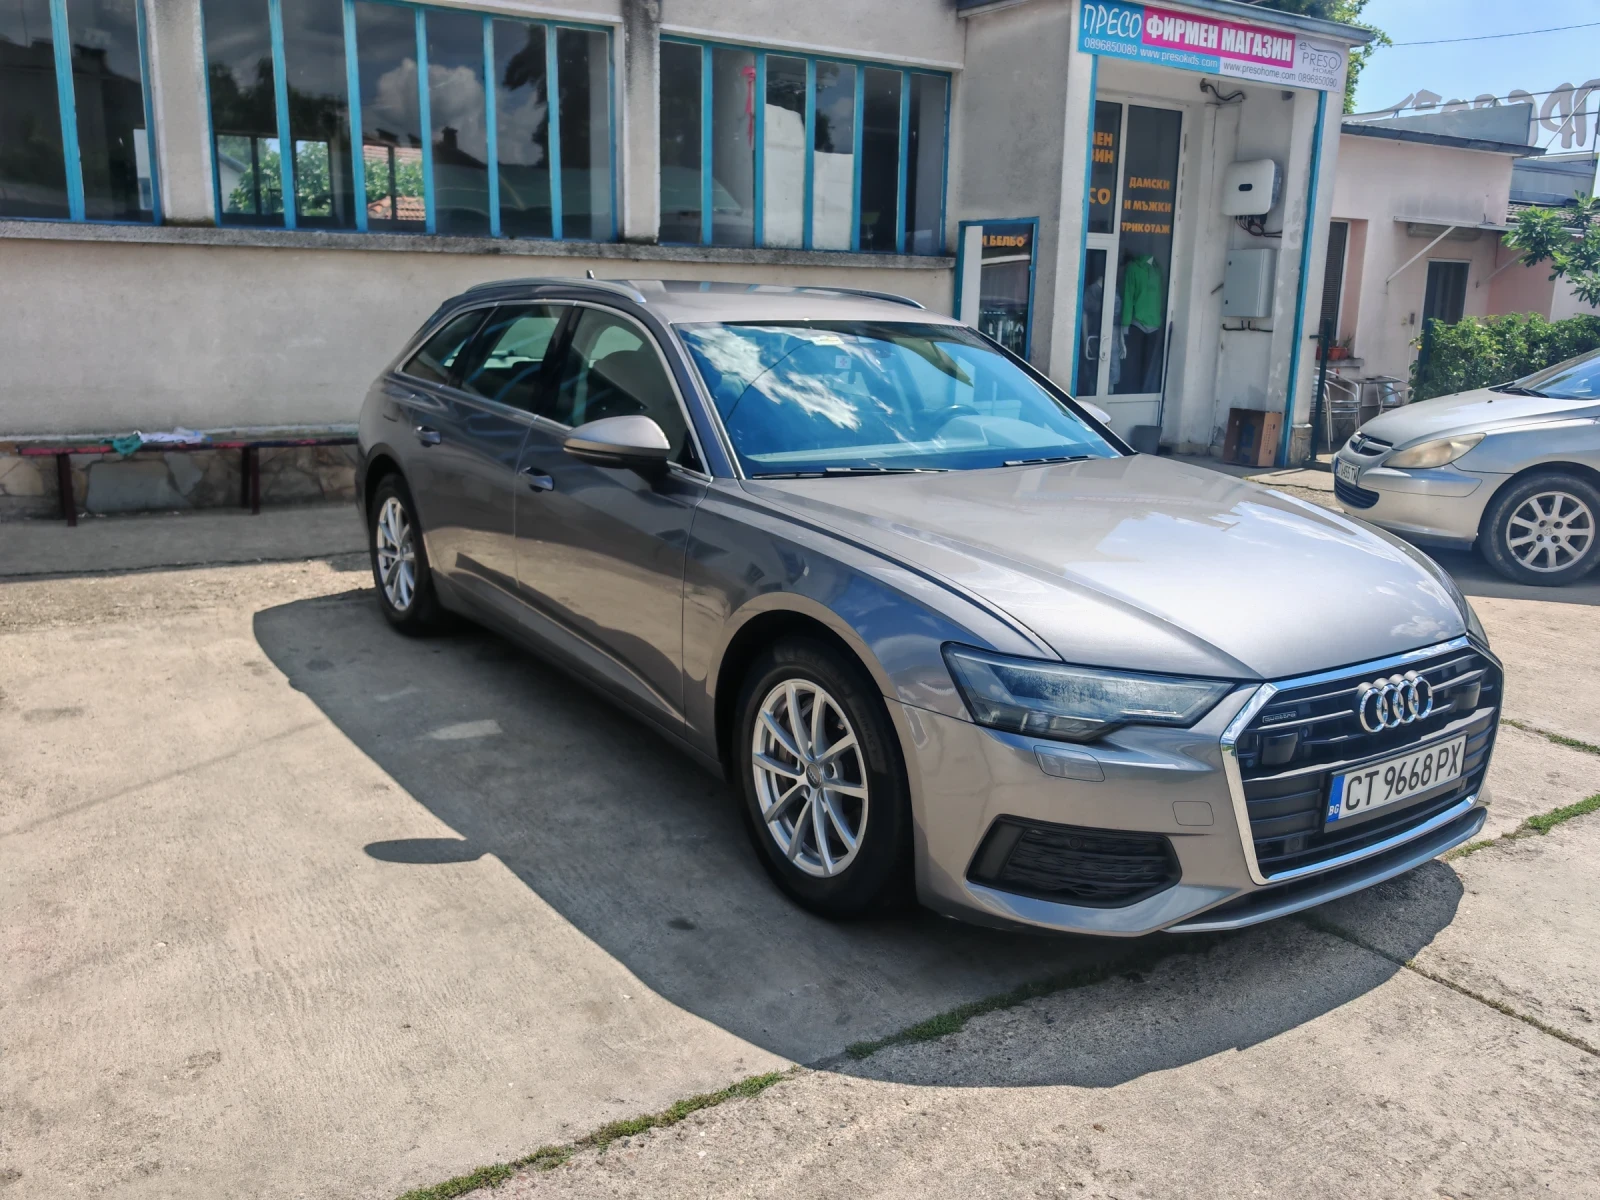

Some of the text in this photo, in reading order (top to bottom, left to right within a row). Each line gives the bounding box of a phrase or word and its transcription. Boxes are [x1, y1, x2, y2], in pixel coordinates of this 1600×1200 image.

[1084, 4, 1142, 38] ПРЕСО
[1146, 14, 1293, 62] ФИРМЕН МАГАЗИН
[1084, 37, 1218, 68] 0896850089 www.presokids.com
[1302, 51, 1338, 70] PRESO
[1223, 61, 1337, 88] www.presohome.com 0896850090
[1312, 67, 1335, 76] HOME
[1129, 176, 1170, 190] ДАМСКИ
[1124, 199, 1171, 213] И МЪЖКИ
[1121, 222, 1170, 234] ТРИКОТАЖ
[990, 235, 1025, 247] БЕЛЬО
[1329, 803, 1340, 816] BG
